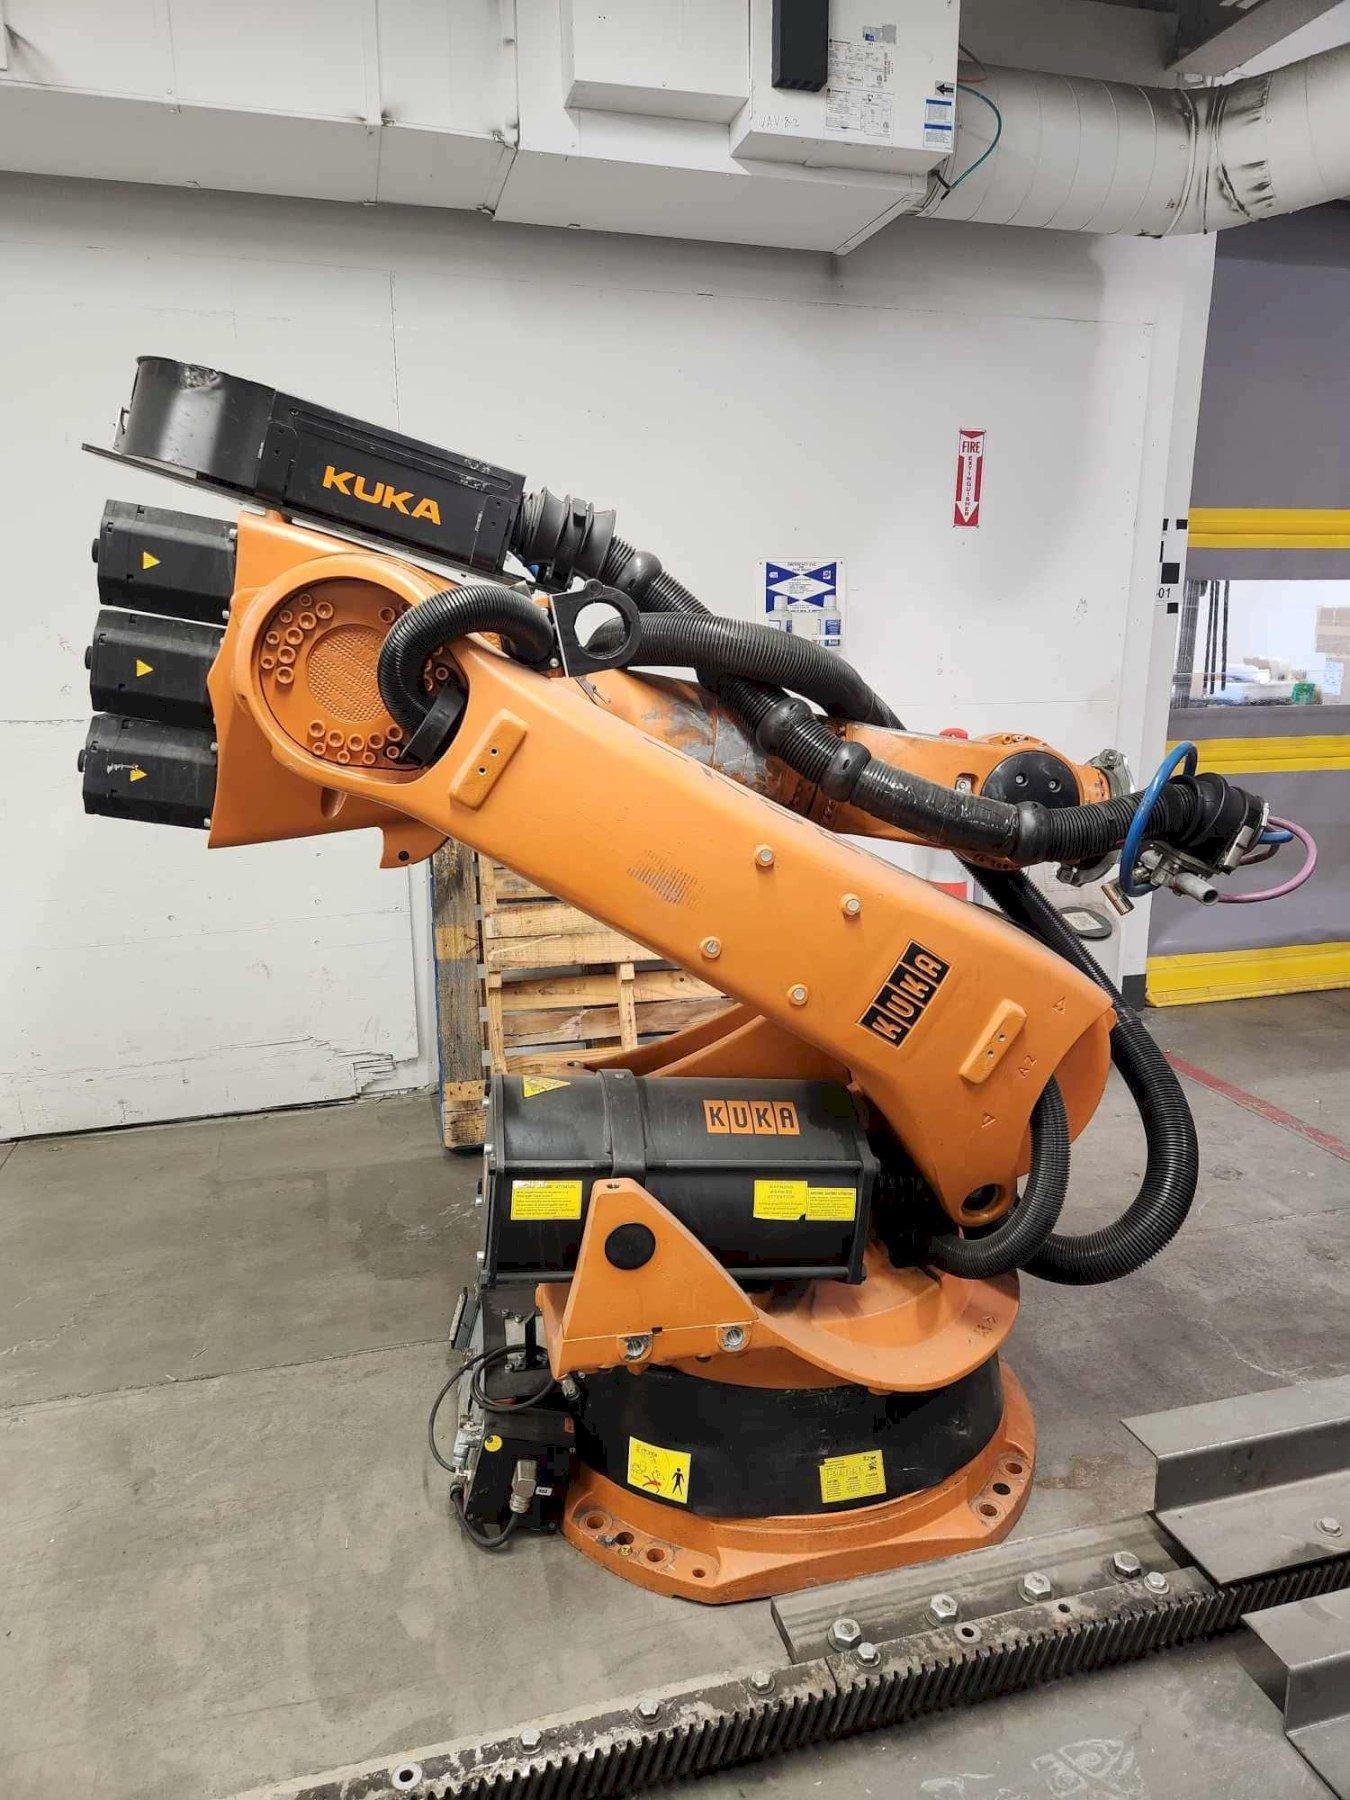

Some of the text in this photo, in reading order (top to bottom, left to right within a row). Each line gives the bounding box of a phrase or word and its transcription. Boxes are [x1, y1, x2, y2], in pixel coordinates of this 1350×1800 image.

[962, 440, 981, 454] FIRE
[322, 465, 442, 526] KUKA
[871, 953, 942, 1040] KUKA
[708, 1106, 795, 1129] KUKA
